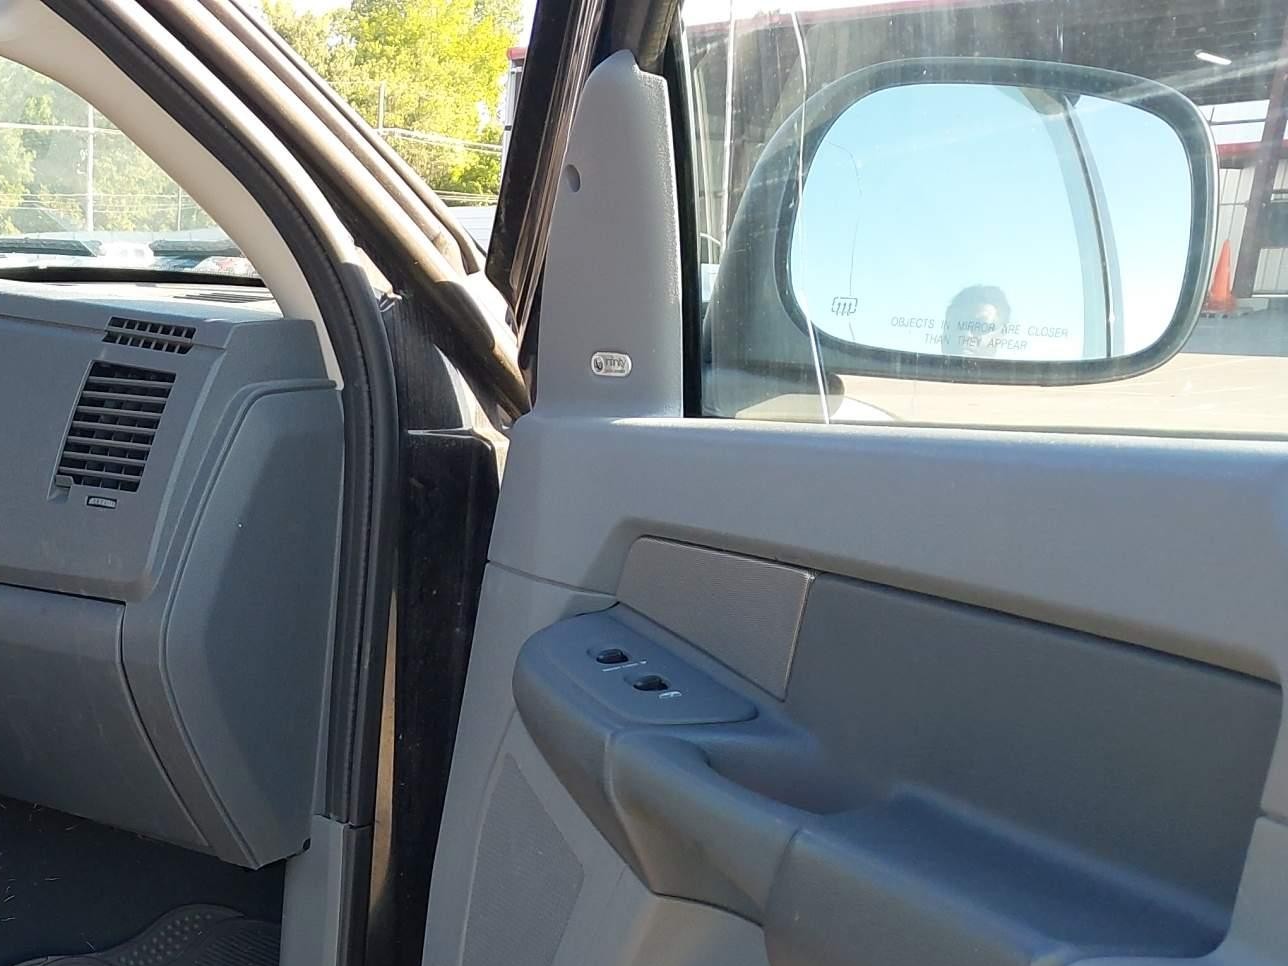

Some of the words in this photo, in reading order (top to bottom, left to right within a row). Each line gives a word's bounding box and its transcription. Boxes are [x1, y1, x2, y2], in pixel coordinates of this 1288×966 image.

[890, 315, 935, 329] OBJECTS
[941, 318, 951, 331] IN
[956, 320, 996, 334] MIRROR
[1000, 323, 1022, 336] ARE
[1027, 325, 1070, 339] CLOSER
[924, 332, 951, 345] THAN
[957, 335, 983, 348] THEY
[987, 337, 1029, 351] APPEAR
